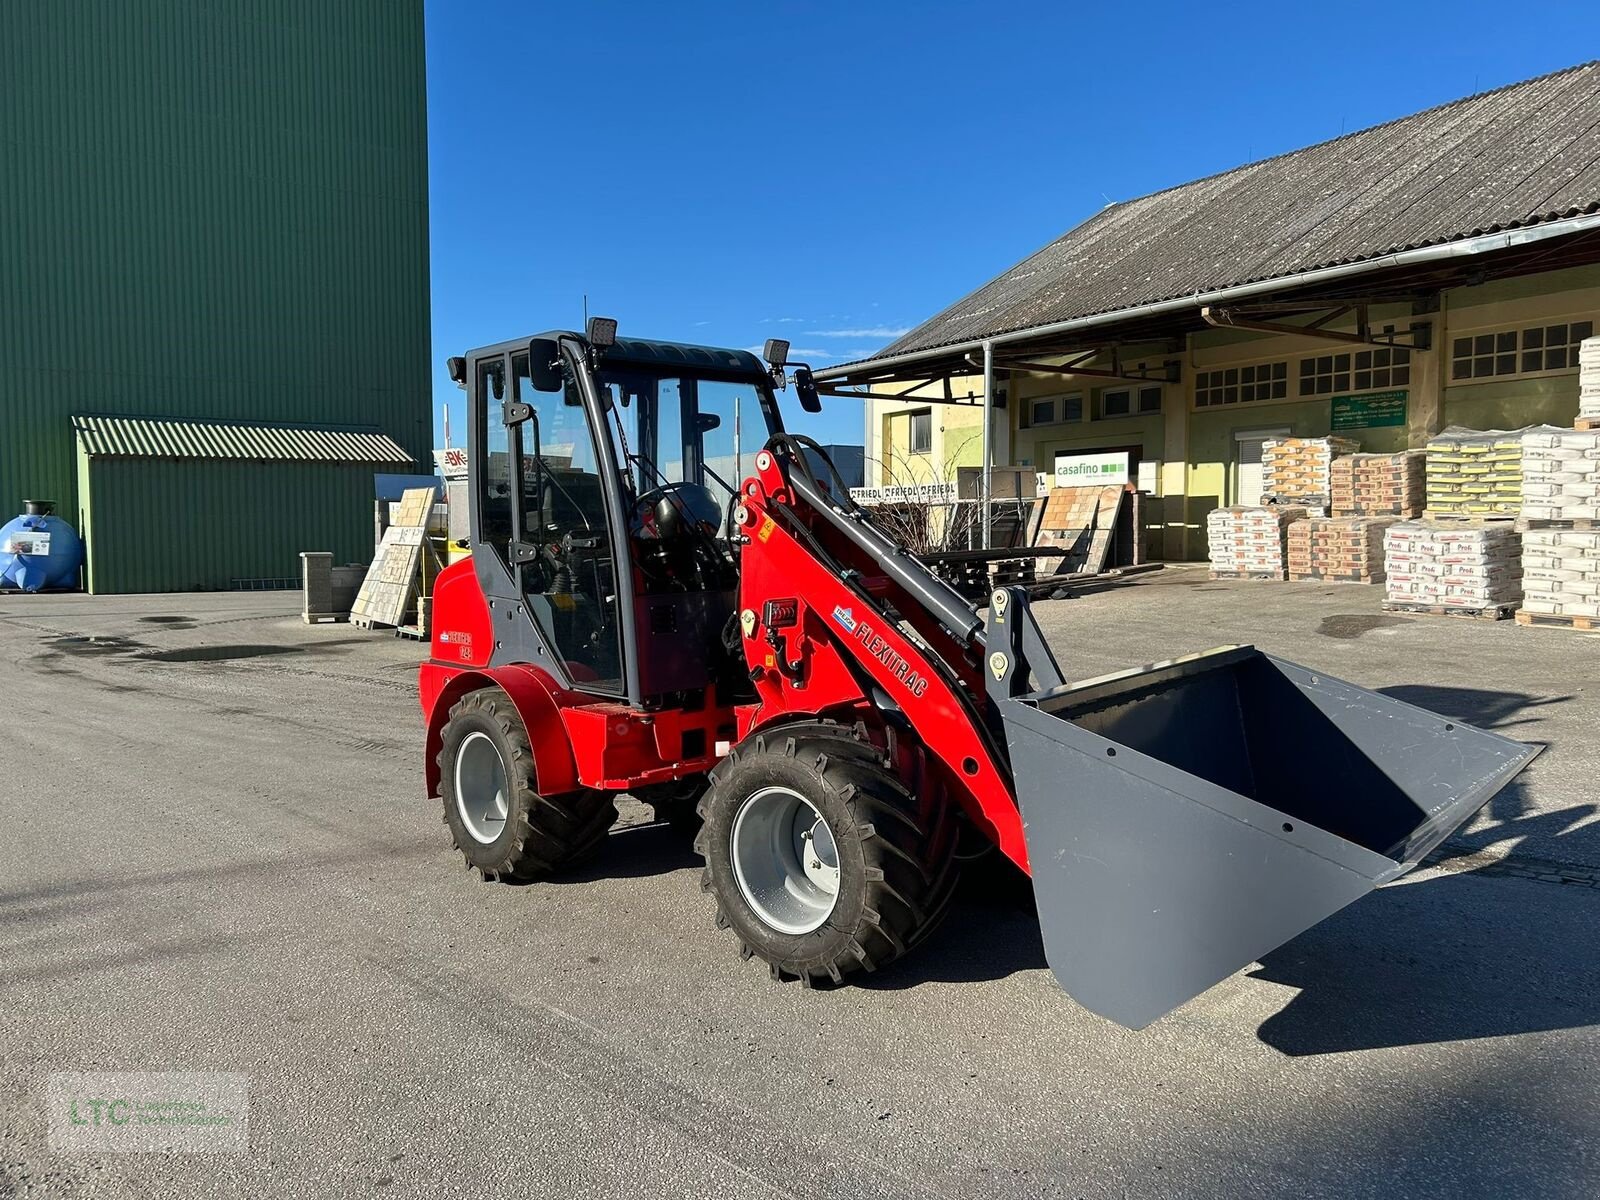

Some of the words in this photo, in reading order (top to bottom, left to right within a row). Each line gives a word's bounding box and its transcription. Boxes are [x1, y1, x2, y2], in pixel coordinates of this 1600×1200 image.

[446, 450, 466, 466] BK
[1057, 463, 1098, 475] casafino
[857, 489, 881, 498] FRIEDL
[891, 487, 918, 497] FRIEDL
[836, 608, 854, 628] TREJON
[854, 621, 928, 698] FLEXITRAC
